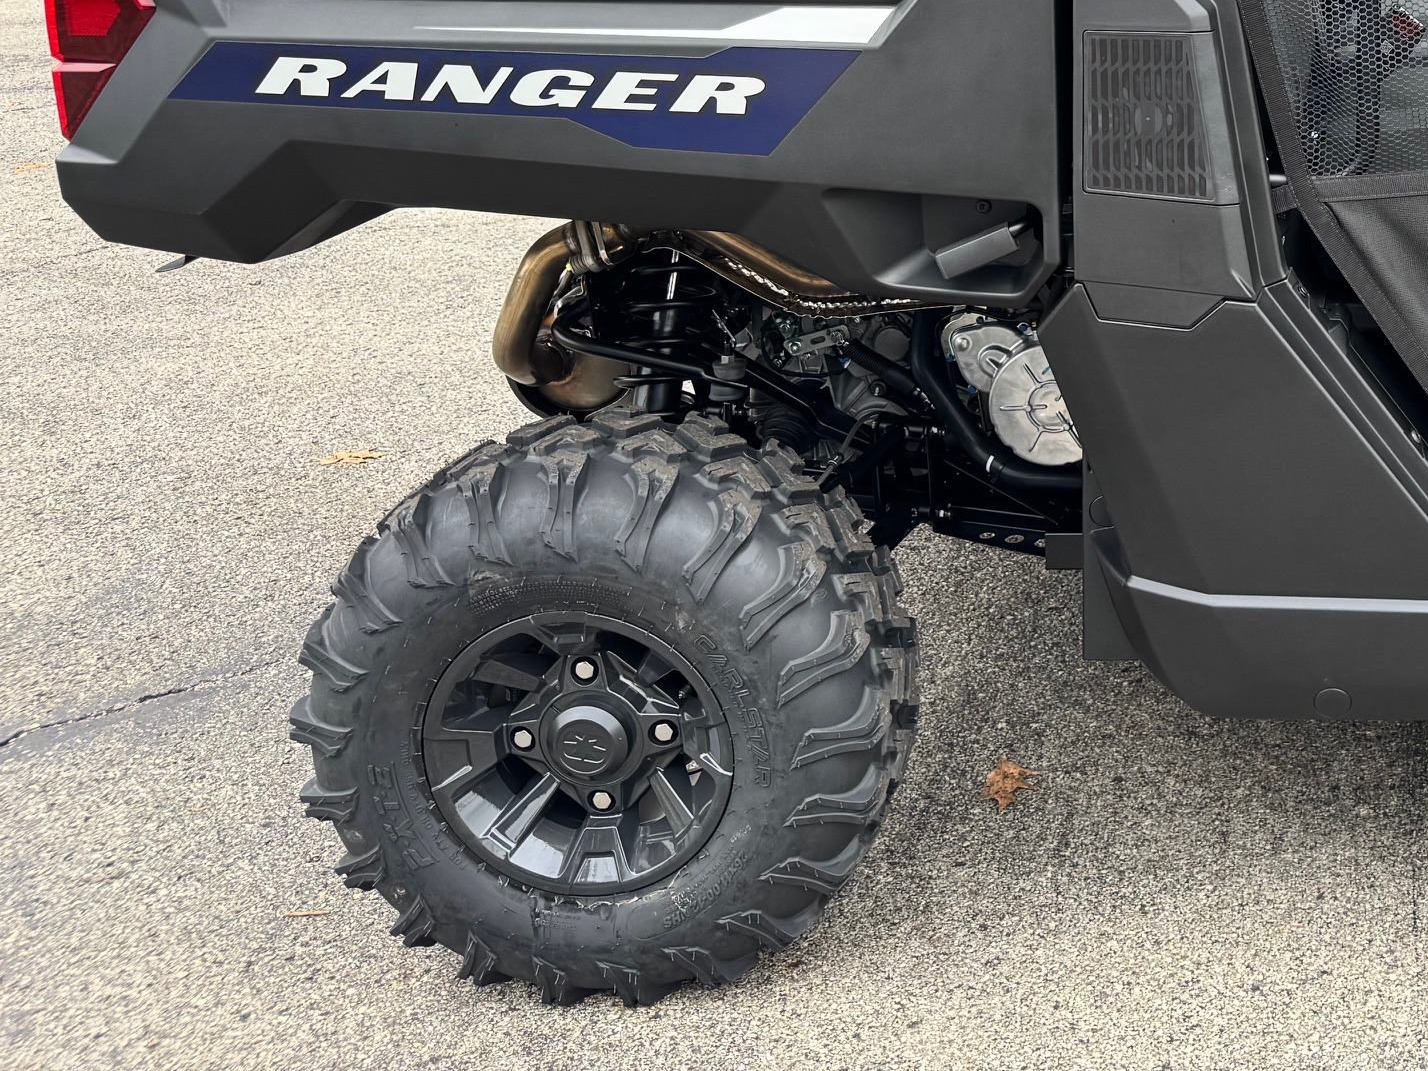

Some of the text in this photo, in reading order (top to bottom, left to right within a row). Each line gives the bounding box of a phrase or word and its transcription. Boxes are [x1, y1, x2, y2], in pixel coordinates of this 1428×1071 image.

[254, 55, 767, 115] RANGER
[694, 634, 772, 788] CARLSTAR
[422, 816, 433, 830] OR
[450, 851, 466, 869] FOR
